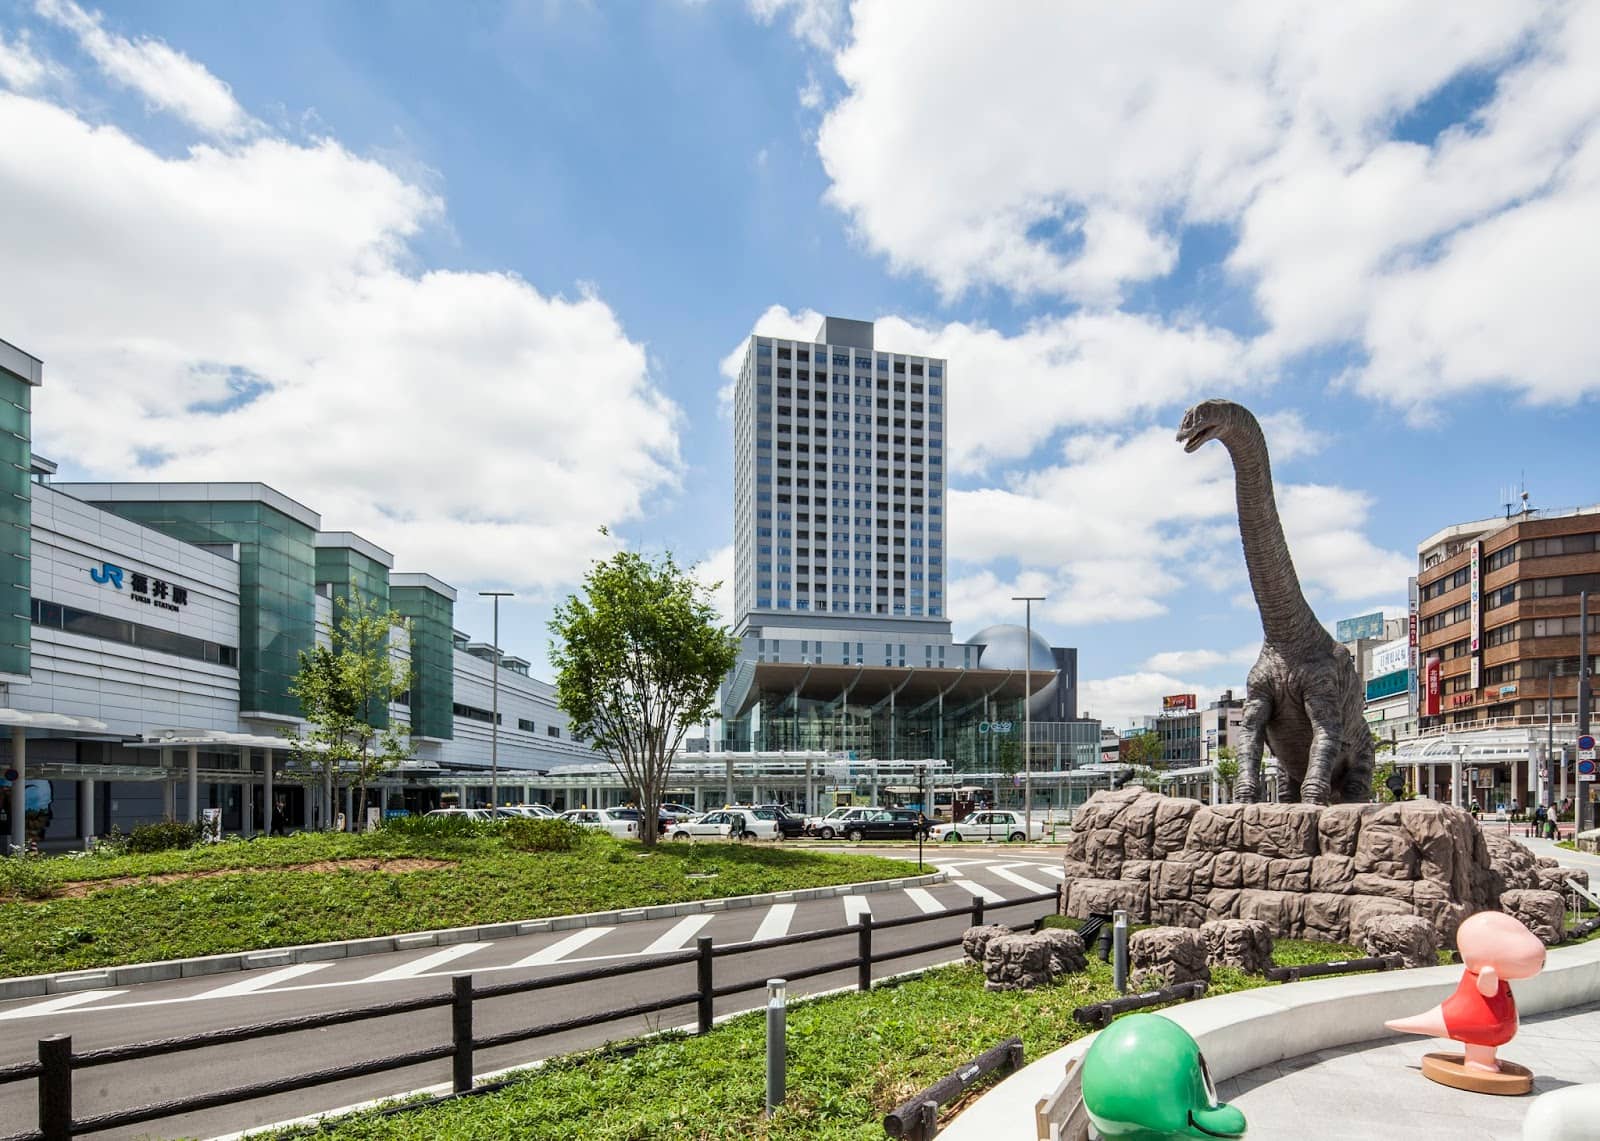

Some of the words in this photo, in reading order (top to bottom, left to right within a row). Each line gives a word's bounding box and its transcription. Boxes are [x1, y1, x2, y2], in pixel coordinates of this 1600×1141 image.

[91, 562, 123, 589] JR
[131, 573, 187, 606] 福井駅
[154, 600, 180, 612] STATION
